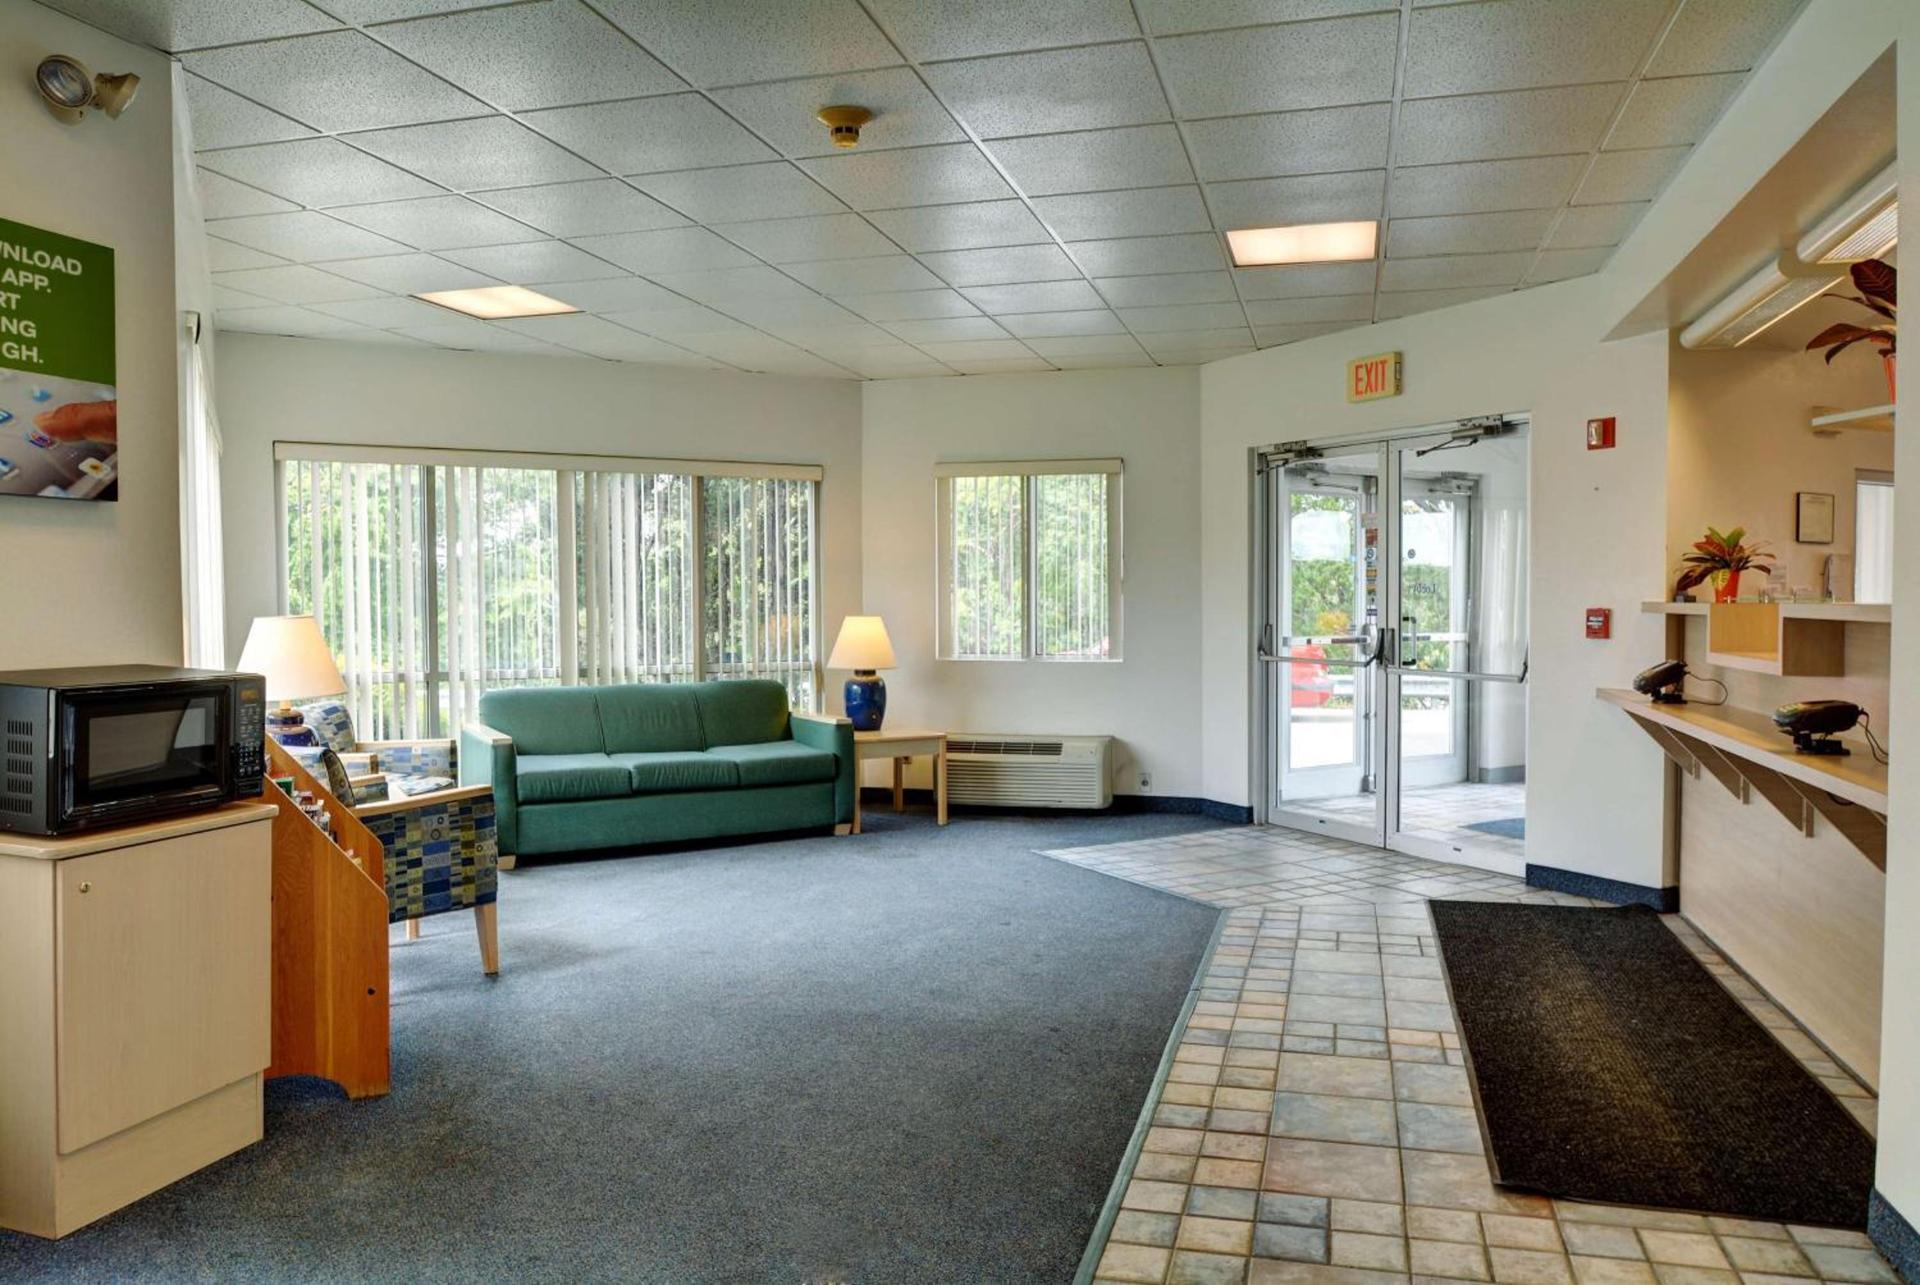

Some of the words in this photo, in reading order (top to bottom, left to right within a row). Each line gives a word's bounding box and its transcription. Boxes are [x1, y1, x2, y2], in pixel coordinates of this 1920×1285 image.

[0, 241, 83, 276] NLOAD
[1, 267, 52, 293] APP.
[1, 315, 37, 339] NG
[1, 341, 44, 364] GH.
[1354, 359, 1388, 396] EXIT
